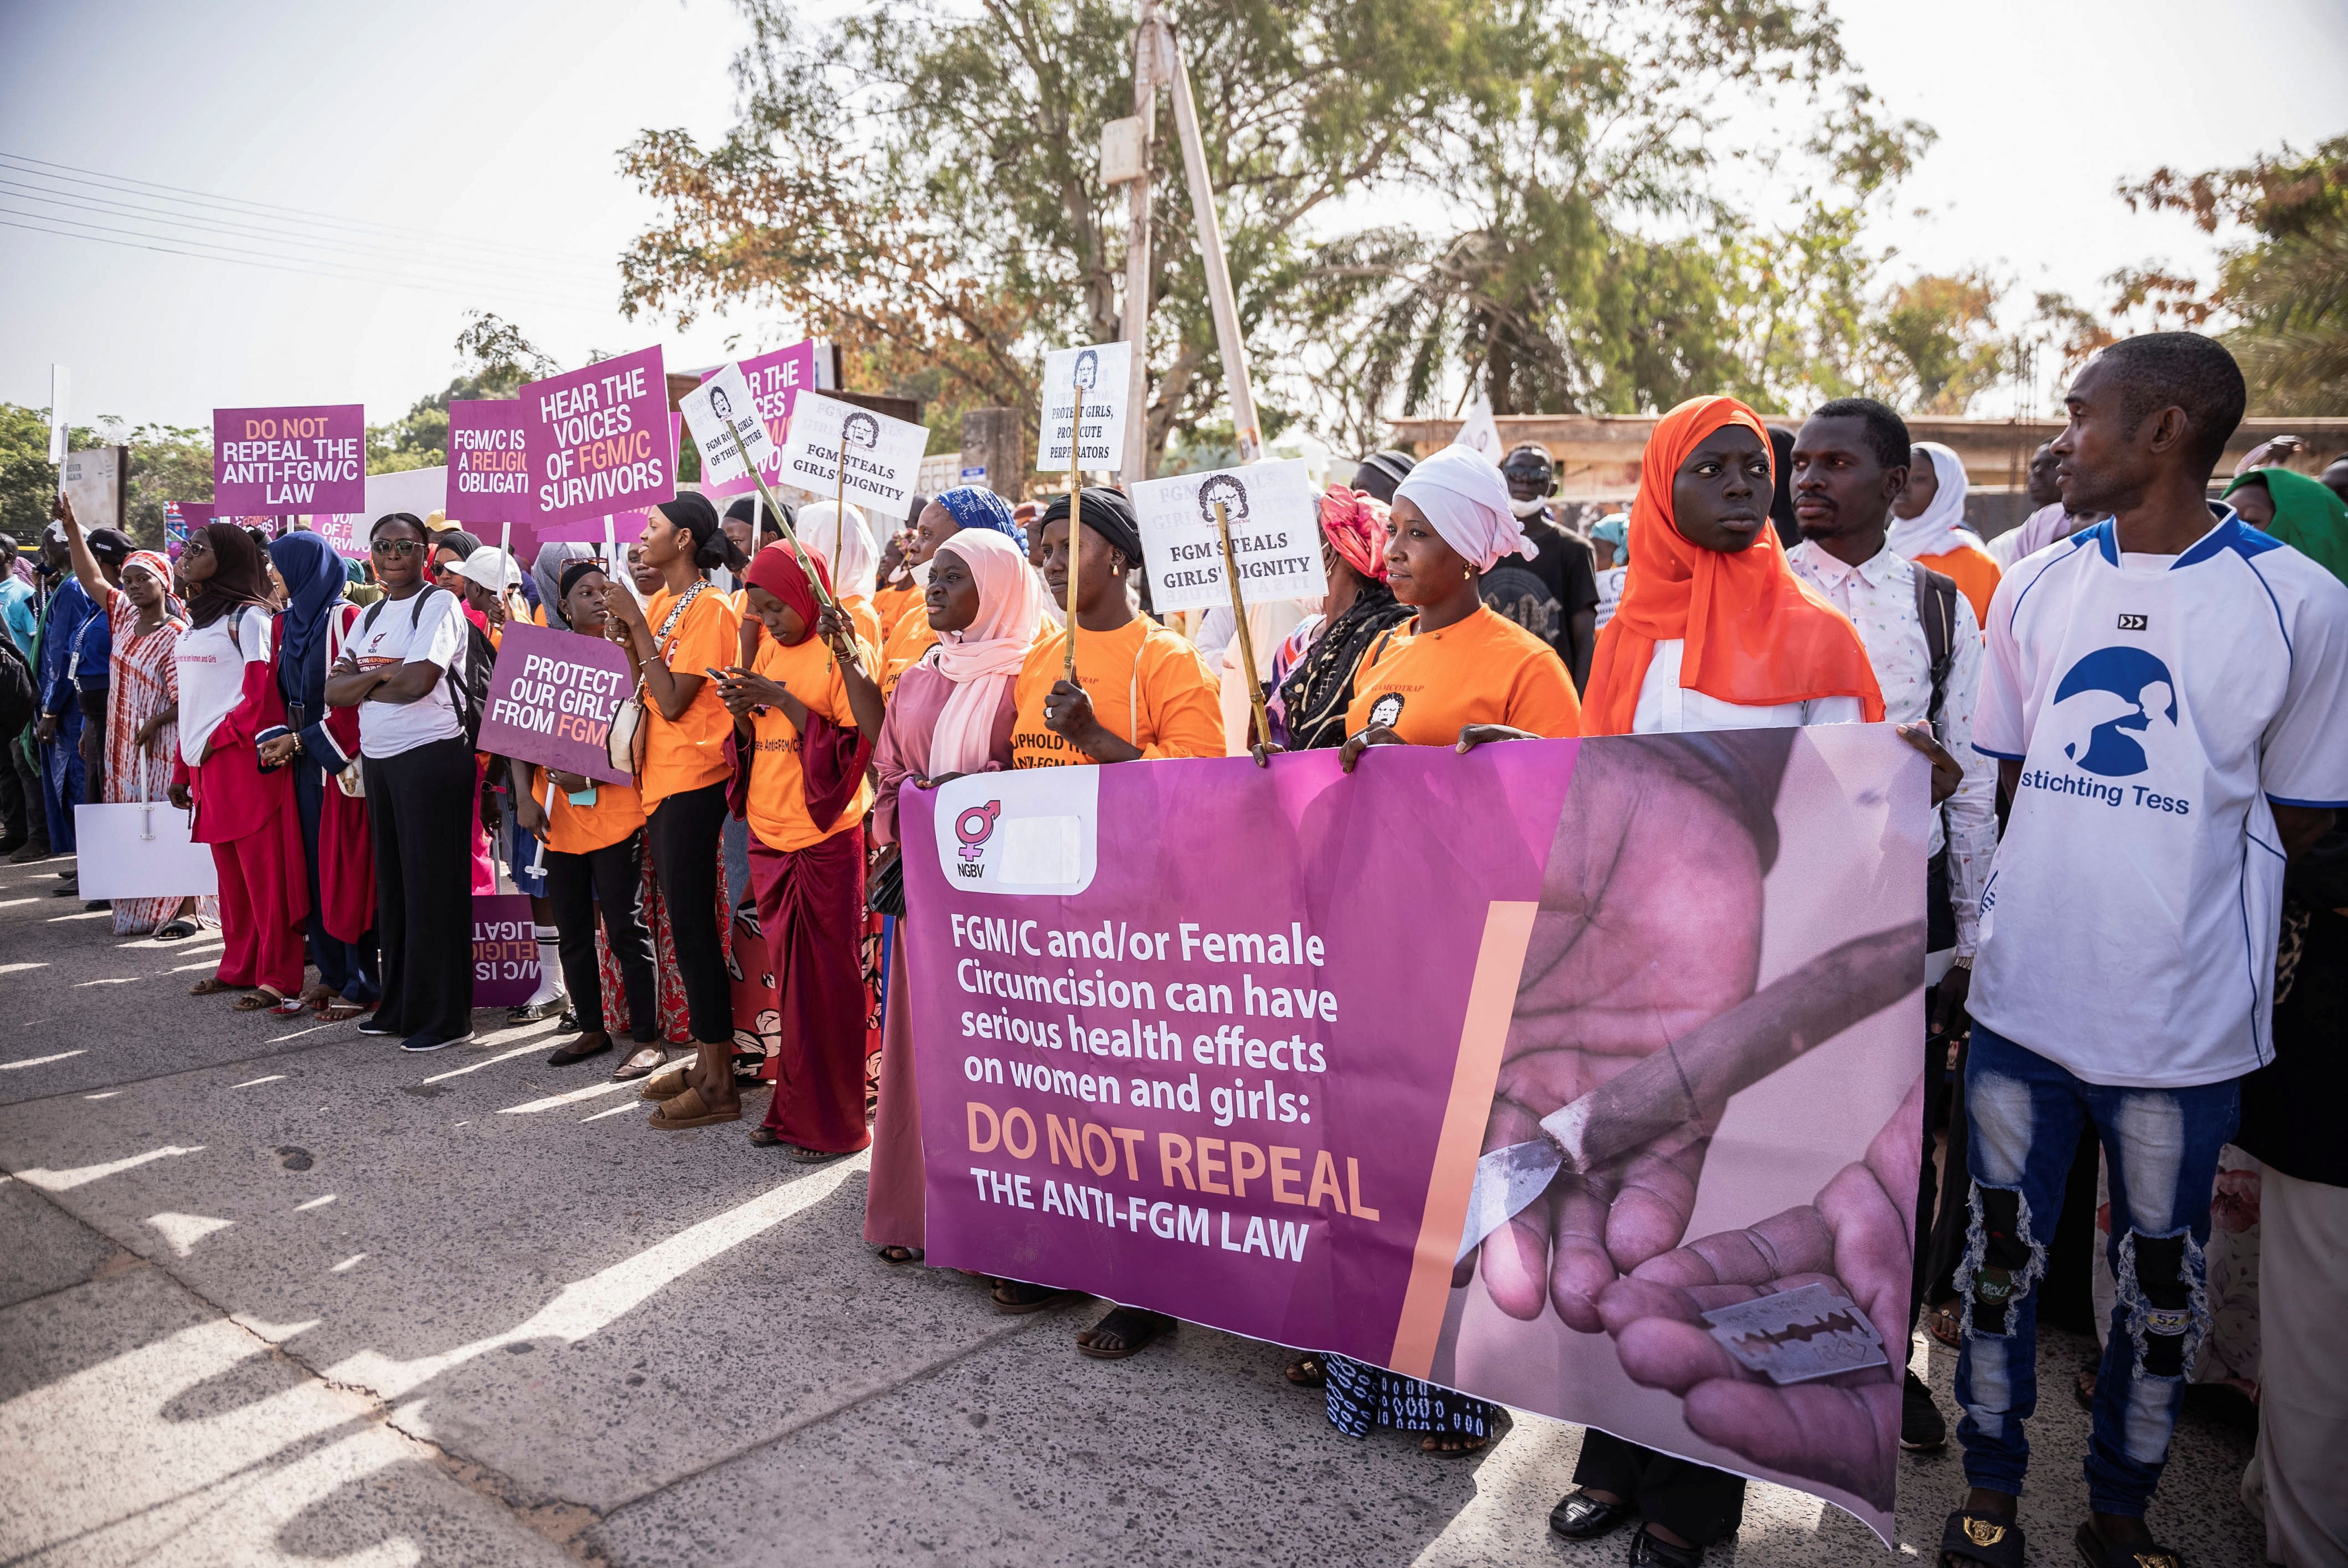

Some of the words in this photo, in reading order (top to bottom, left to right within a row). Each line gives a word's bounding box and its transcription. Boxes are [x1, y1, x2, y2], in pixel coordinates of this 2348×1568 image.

[764, 358, 800, 392] THE
[540, 382, 599, 423] HEAR
[601, 367, 647, 405] THE
[1051, 405, 1084, 419] PROTET
[1086, 405, 1113, 420] GIRLS,
[246, 419, 277, 440] DO
[283, 417, 328, 438] NOT
[454, 429, 507, 451] FGM/C
[510, 429, 525, 450] IS
[553, 404, 632, 449] VOICES
[705, 436, 722, 452] FGM
[737, 416, 754, 432] GIRLS
[1057, 426, 1102, 439] PROSCUTE
[223, 440, 309, 462] REPEAL
[313, 438, 358, 460] THE
[458, 452, 469, 471] A
[546, 449, 574, 481] OF
[578, 430, 651, 473] FGM/C
[711, 453, 721, 466] OF
[720, 443, 741, 461] THEI
[741, 429, 762, 449] FUTURE
[806, 443, 840, 463] FGM
[841, 454, 895, 479] STEALS
[222, 460, 358, 484] ANTI-FGM/C
[459, 472, 529, 493] OBLIGATI
[540, 458, 663, 512] SURVIVORS
[793, 459, 840, 480] GIRLS'
[842, 472, 905, 501] DIGNITY
[266, 483, 315, 504] LAW
[322, 522, 342, 536] OF
[1170, 542, 1212, 562] FGM
[1163, 565, 1222, 588] GIRLS'
[523, 654, 624, 696] PROTECT
[1371, 684, 1425, 692] GAMCOTRAP
[491, 698, 555, 734] FROM
[510, 677, 556, 708] OUR
[559, 688, 622, 723] GIRLS
[2021, 770, 2123, 807] stichting
[2132, 785, 2190, 815] Tess
[957, 863, 985, 878] NGBV
[951, 913, 1041, 956] FGM/C
[1047, 920, 1170, 962] and/or
[1179, 922, 1325, 967] Female
[475, 962, 497, 981] IS
[957, 958, 1156, 1010] Circumcision
[1165, 982, 1233, 1014] can
[1243, 973, 1338, 1022] have
[961, 1006, 1063, 1049] serious
[1067, 1014, 1183, 1061] health
[1192, 1024, 1327, 1073] effects
[964, 1056, 1004, 1084] on
[1009, 1060, 1121, 1105] women
[1130, 1073, 1200, 1113] and
[1210, 1078, 1311, 1127] girls:
[967, 1102, 1037, 1160] DO
[1046, 1113, 1145, 1182] NOT
[1159, 1132, 1380, 1222] REPEAL
[970, 1167, 1035, 1210] THE
[1043, 1179, 1210, 1247] ANTI-FGM
[1221, 1211, 1310, 1263] LAW
[2157, 1314, 2179, 1326] 52
